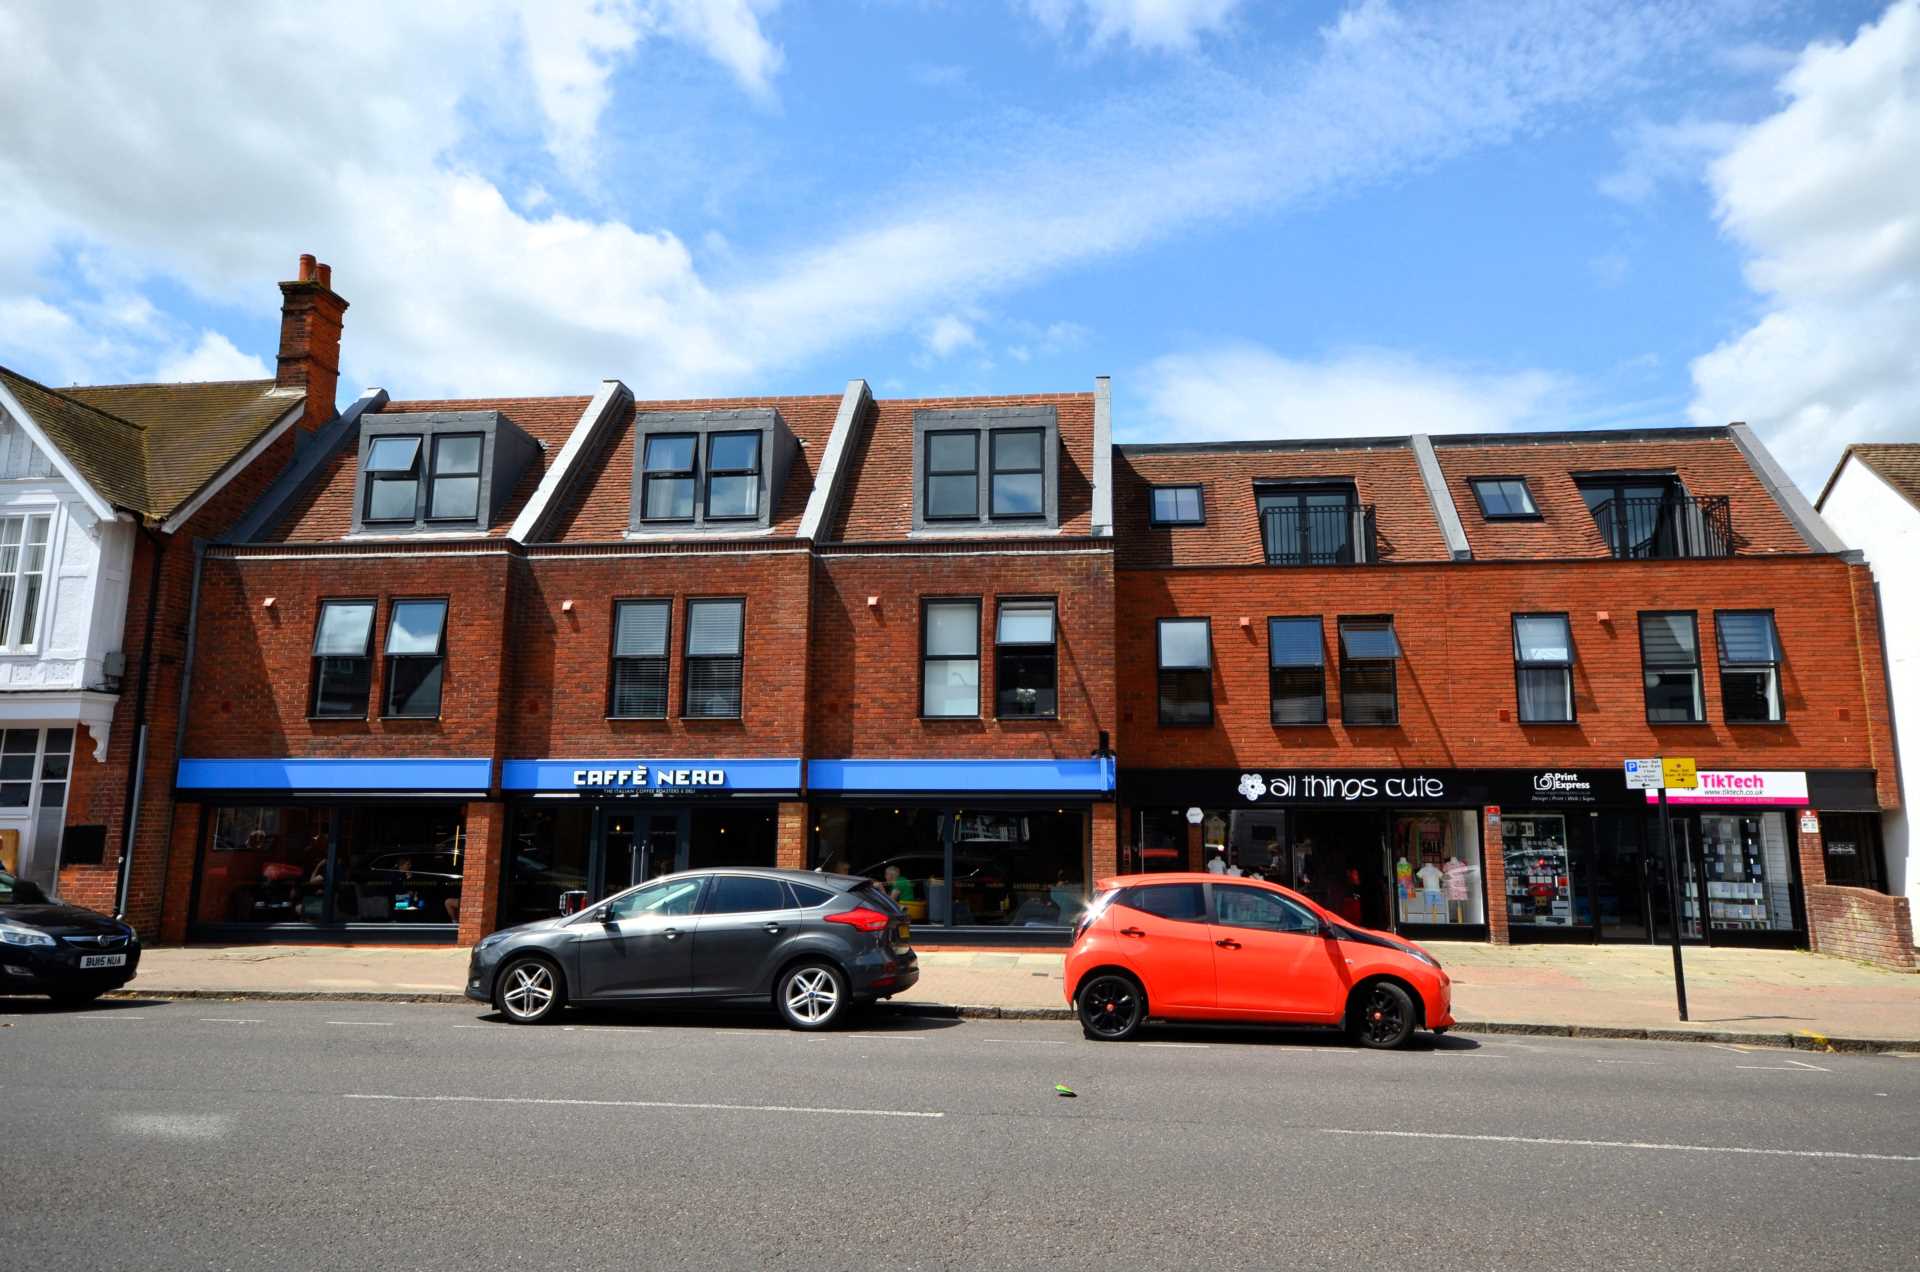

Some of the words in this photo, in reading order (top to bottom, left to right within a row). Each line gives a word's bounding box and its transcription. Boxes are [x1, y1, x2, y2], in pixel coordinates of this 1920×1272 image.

[573, 764, 647, 785] CAFFÈ
[657, 769, 724, 785] NERO
[1554, 772, 1578, 781] Print
[1700, 774, 1764, 788] TikTech
[1270, 775, 1296, 797] all
[1302, 774, 1378, 801] things
[1385, 775, 1444, 797] cute
[1555, 780, 1590, 791] Express
